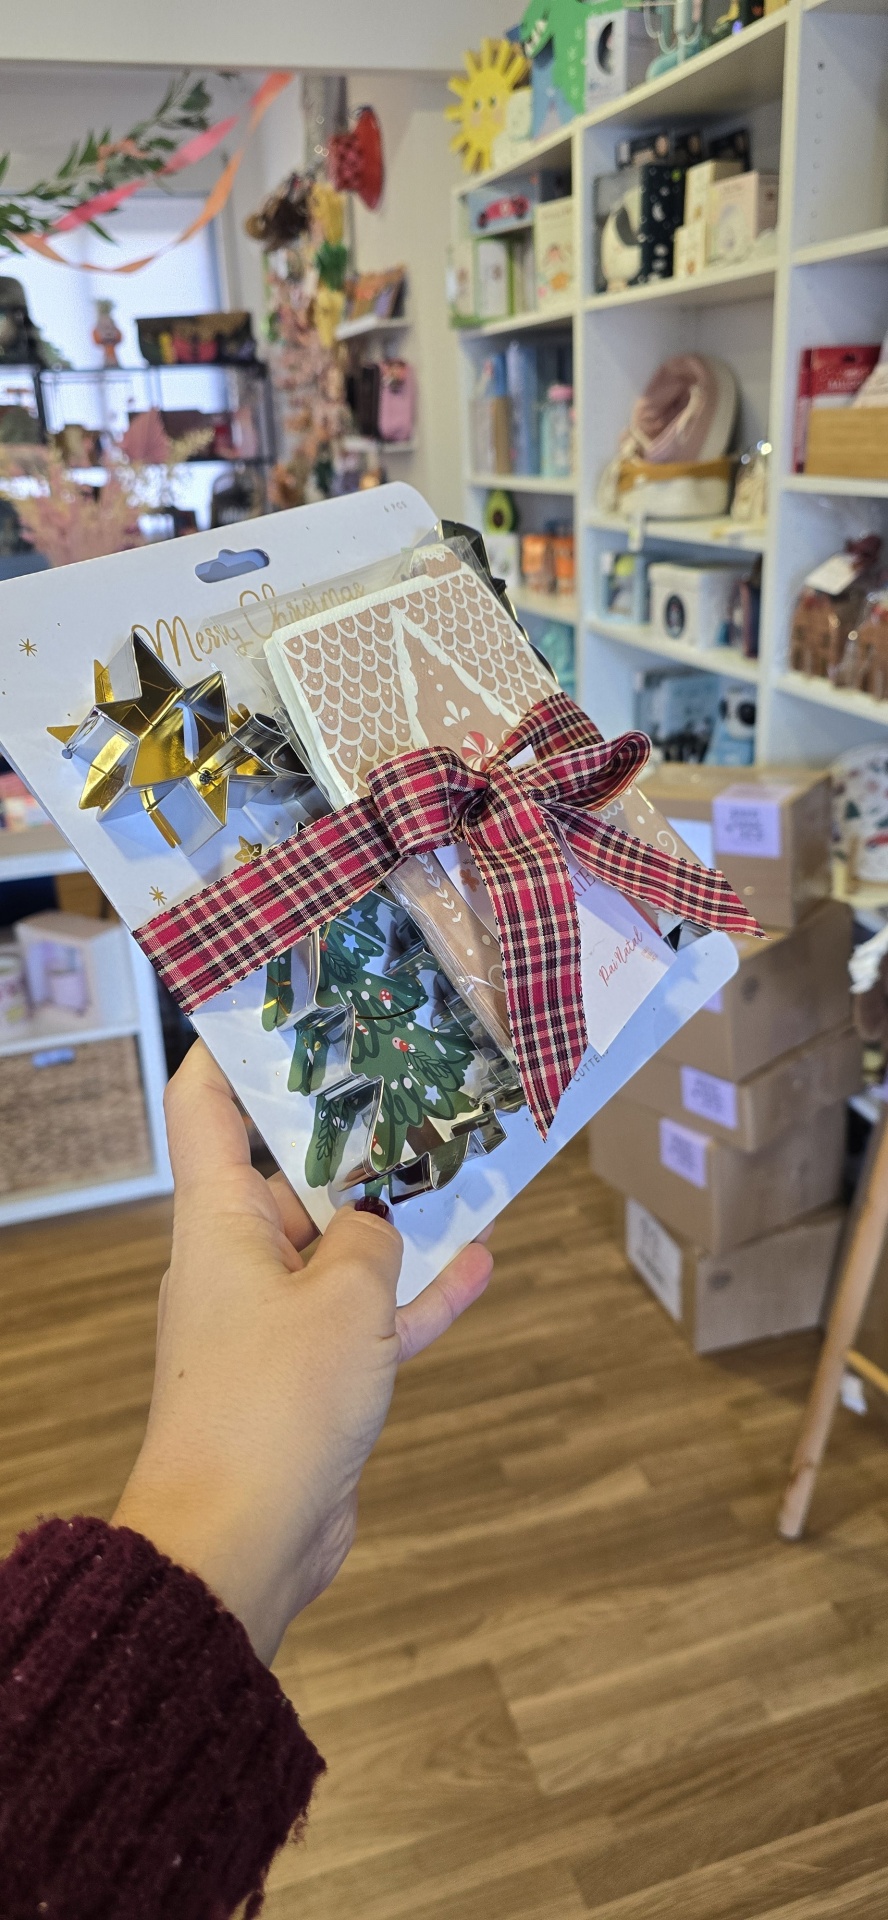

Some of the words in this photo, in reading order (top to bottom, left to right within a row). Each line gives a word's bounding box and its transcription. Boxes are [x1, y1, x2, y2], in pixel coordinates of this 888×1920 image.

[131, 616, 253, 667] Merry
[239, 582, 364, 639] Christmas
[598, 959, 619, 987] Pai
[614, 925, 643, 964] Natal
[573, 1050, 609, 1082] CUTTE
